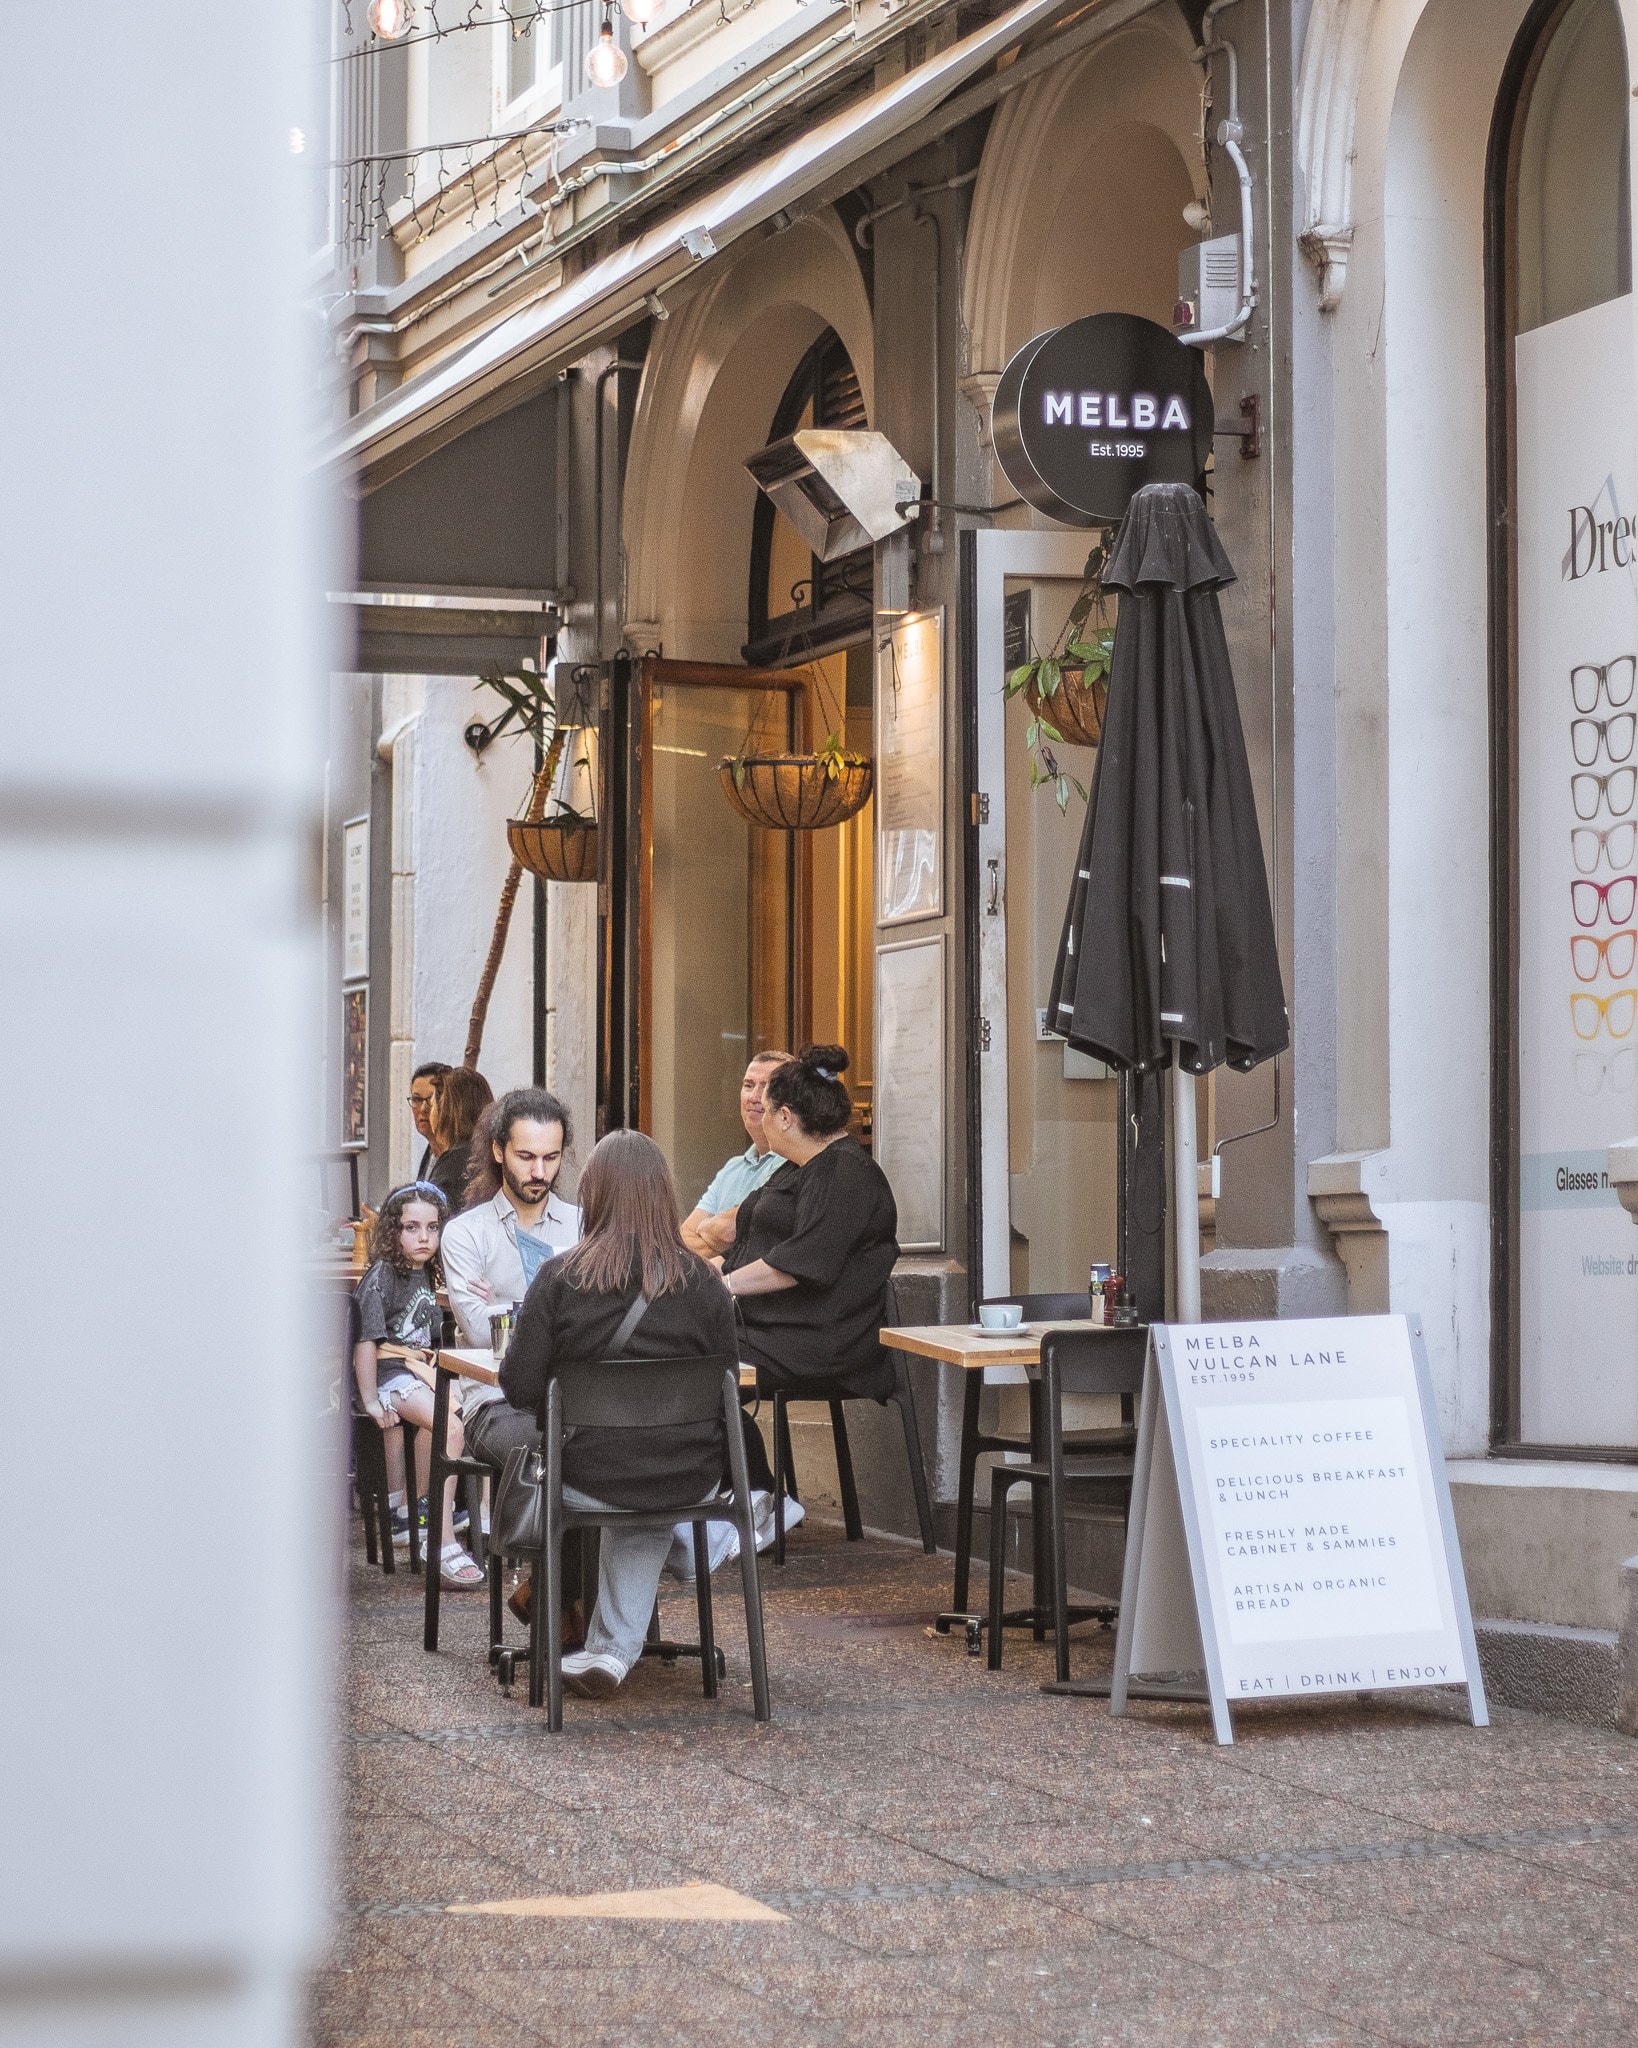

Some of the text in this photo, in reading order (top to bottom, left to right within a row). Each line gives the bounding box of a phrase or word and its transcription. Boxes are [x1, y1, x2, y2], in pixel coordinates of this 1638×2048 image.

[1045, 394, 1189, 430] MELBA
[1090, 443, 1145, 458] Est.1995
[1556, 1166, 1598, 1191] Glasses
[1581, 1254, 1625, 1276] Website:
[1185, 1335, 1260, 1351] MELBA
[1187, 1351, 1347, 1371] VULCAN LANE
[1191, 1372, 1256, 1385] EST.1995
[1210, 1430, 1373, 1449] SPECIALITY COFFEE
[1216, 1467, 1405, 1488] DELICIOUS BREAKFAST
[1218, 1489, 1289, 1503] & LUNCH
[1224, 1524, 1349, 1542] FRESHLY MADE
[1227, 1536, 1396, 1557] CABINET & SAMMIES
[1233, 1576, 1386, 1596] ARTISAN ORGANIC
[1235, 1598, 1290, 1611] BREAD
[1239, 1677, 1275, 1691] EAT
[1300, 1671, 1362, 1687] DRINK
[1386, 1665, 1449, 1681] ENJOY
